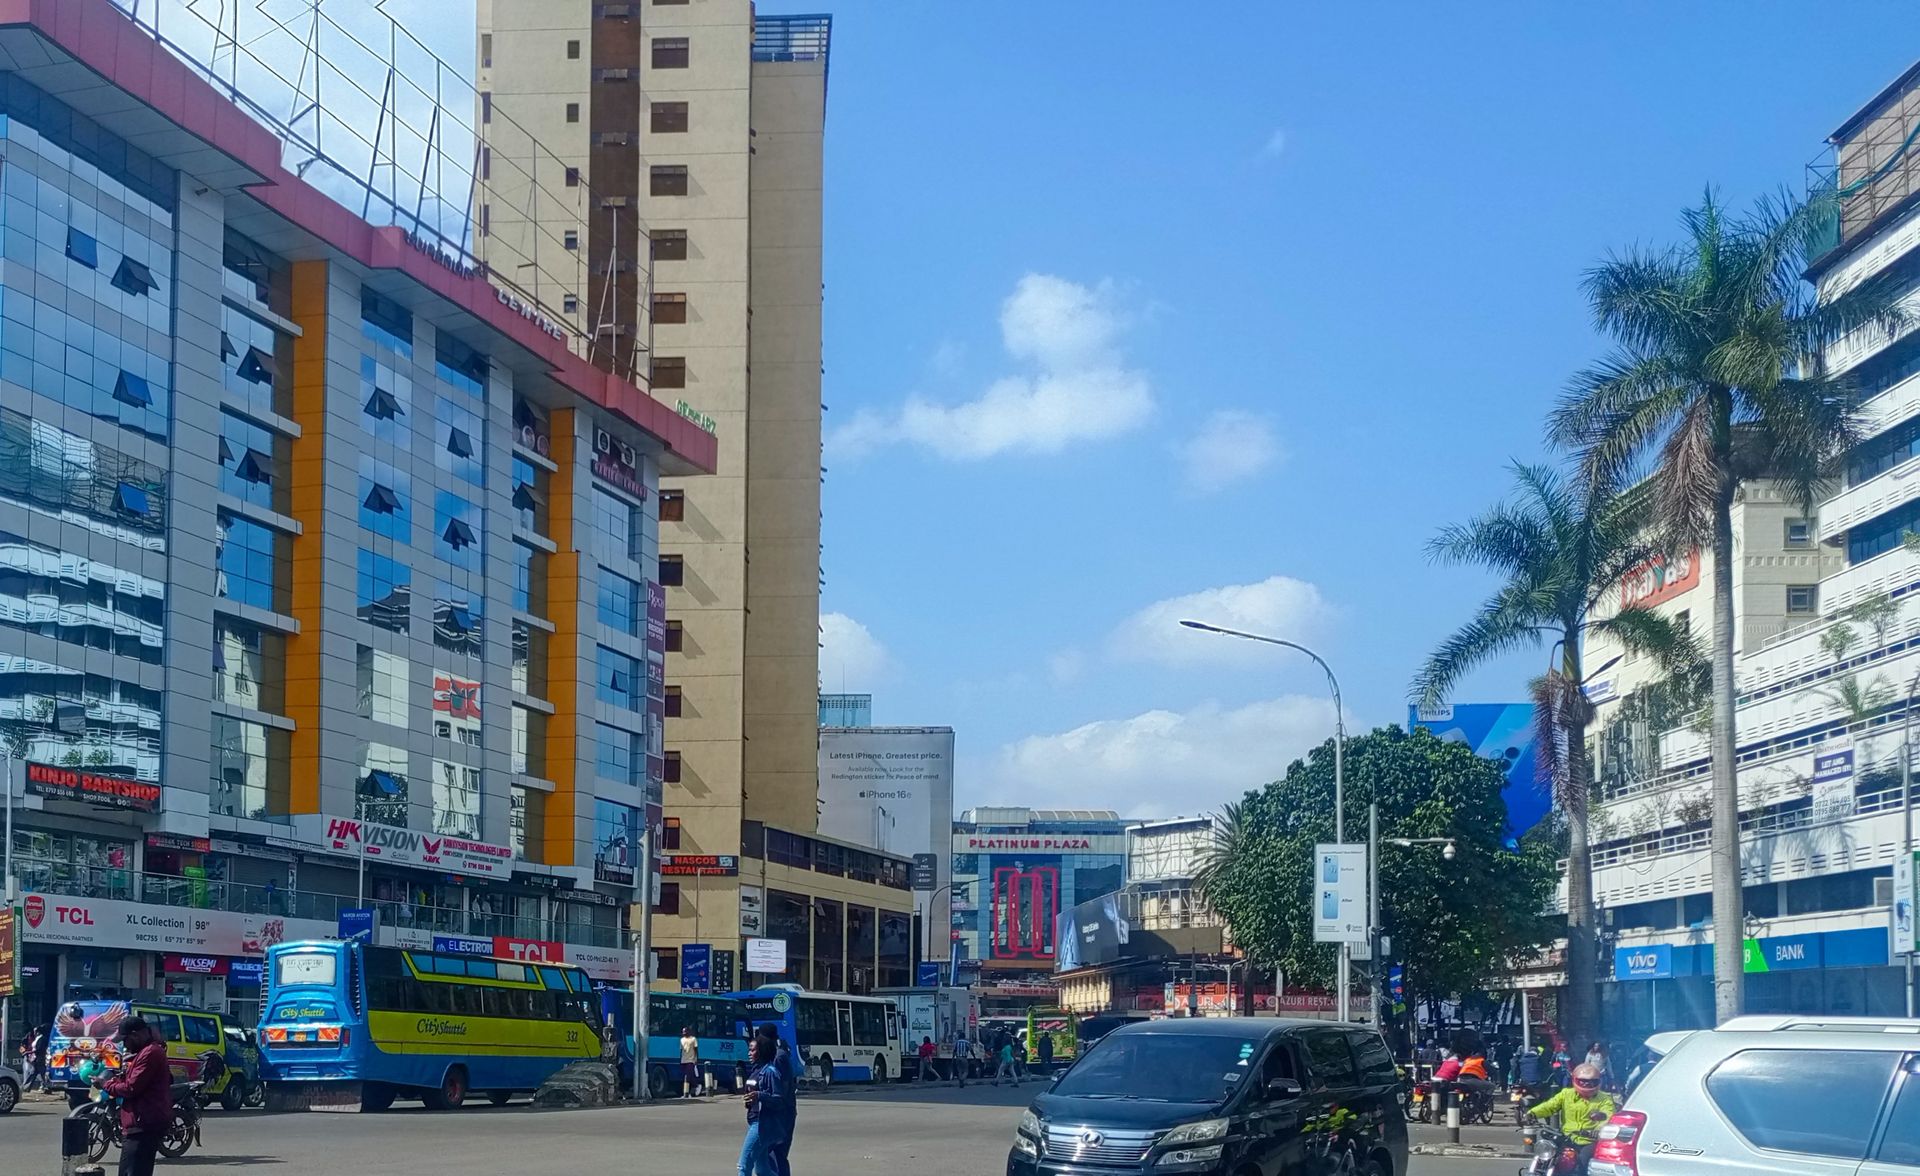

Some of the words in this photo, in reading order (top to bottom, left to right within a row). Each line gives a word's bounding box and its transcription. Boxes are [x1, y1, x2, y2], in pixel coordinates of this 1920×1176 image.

[497, 288, 562, 340] CENTRE
[829, 752, 854, 760] Latest
[855, 752, 884, 760] iPhone.
[885, 752, 919, 760] Greatest
[920, 752, 943, 761] price.
[831, 773, 864, 781] Redington
[81, 774, 161, 801] BABYSHOP
[866, 790, 896, 799] iPhone
[327, 818, 420, 852] HIKVISION
[969, 839, 1040, 848] PLATINUM
[1044, 839, 1089, 849] PLAZA
[674, 856, 717, 865] NASCOS
[661, 866, 726, 875] RESTAURANT
[55, 906, 94, 925] TCL
[126, 914, 138, 925] XL
[141, 915, 185, 929] Collection
[46, 933, 71, 941] REGIONAL
[448, 941, 493, 953] ELECTRON
[509, 943, 547, 962] TCL
[1776, 944, 1805, 961] BANK
[180, 957, 217, 968] HIKSEMI
[576, 953, 586, 961] TCL
[1627, 951, 1657, 968] vivo
[1181, 996, 1214, 1008] AURI
[1280, 996, 1305, 1006] AZURI
[280, 1008, 298, 1019] City
[299, 1007, 325, 1018] Shuttle
[416, 1017, 439, 1036] City
[438, 1020, 467, 1036] Shuttle
